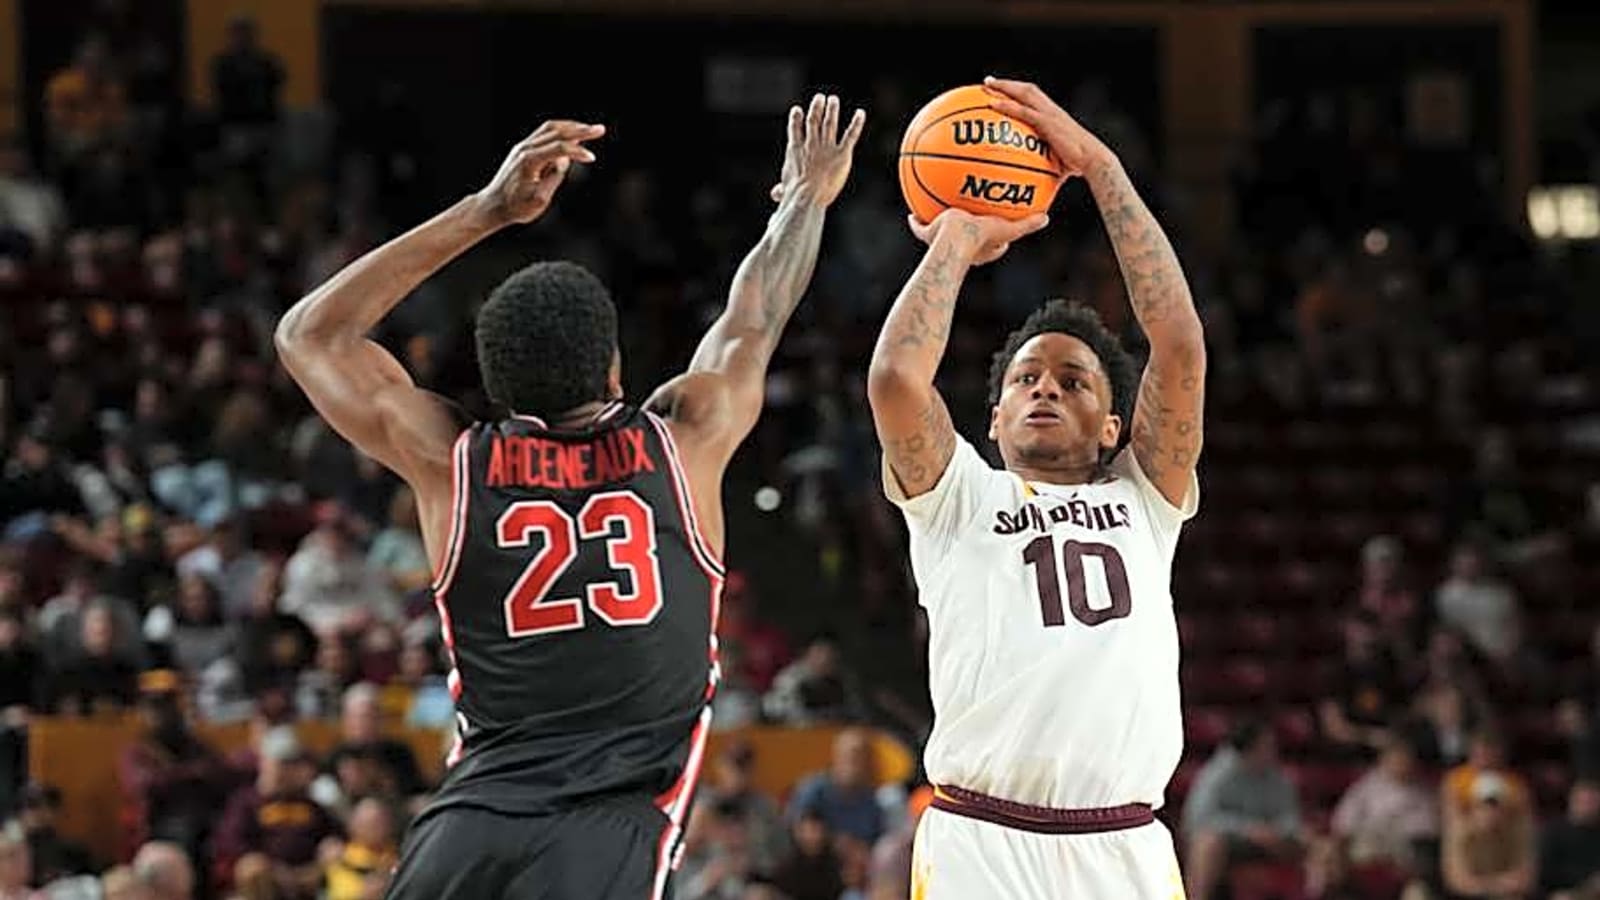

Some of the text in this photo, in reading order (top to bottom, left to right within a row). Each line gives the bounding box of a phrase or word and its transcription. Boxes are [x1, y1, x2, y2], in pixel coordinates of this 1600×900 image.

[952, 119, 1050, 158] Wilson
[961, 174, 1036, 205] NCAA
[486, 428, 655, 488] ARCENEAUX
[993, 499, 1131, 535] SUN DEVILS
[496, 490, 663, 638] 23
[1022, 535, 1132, 627] 10
